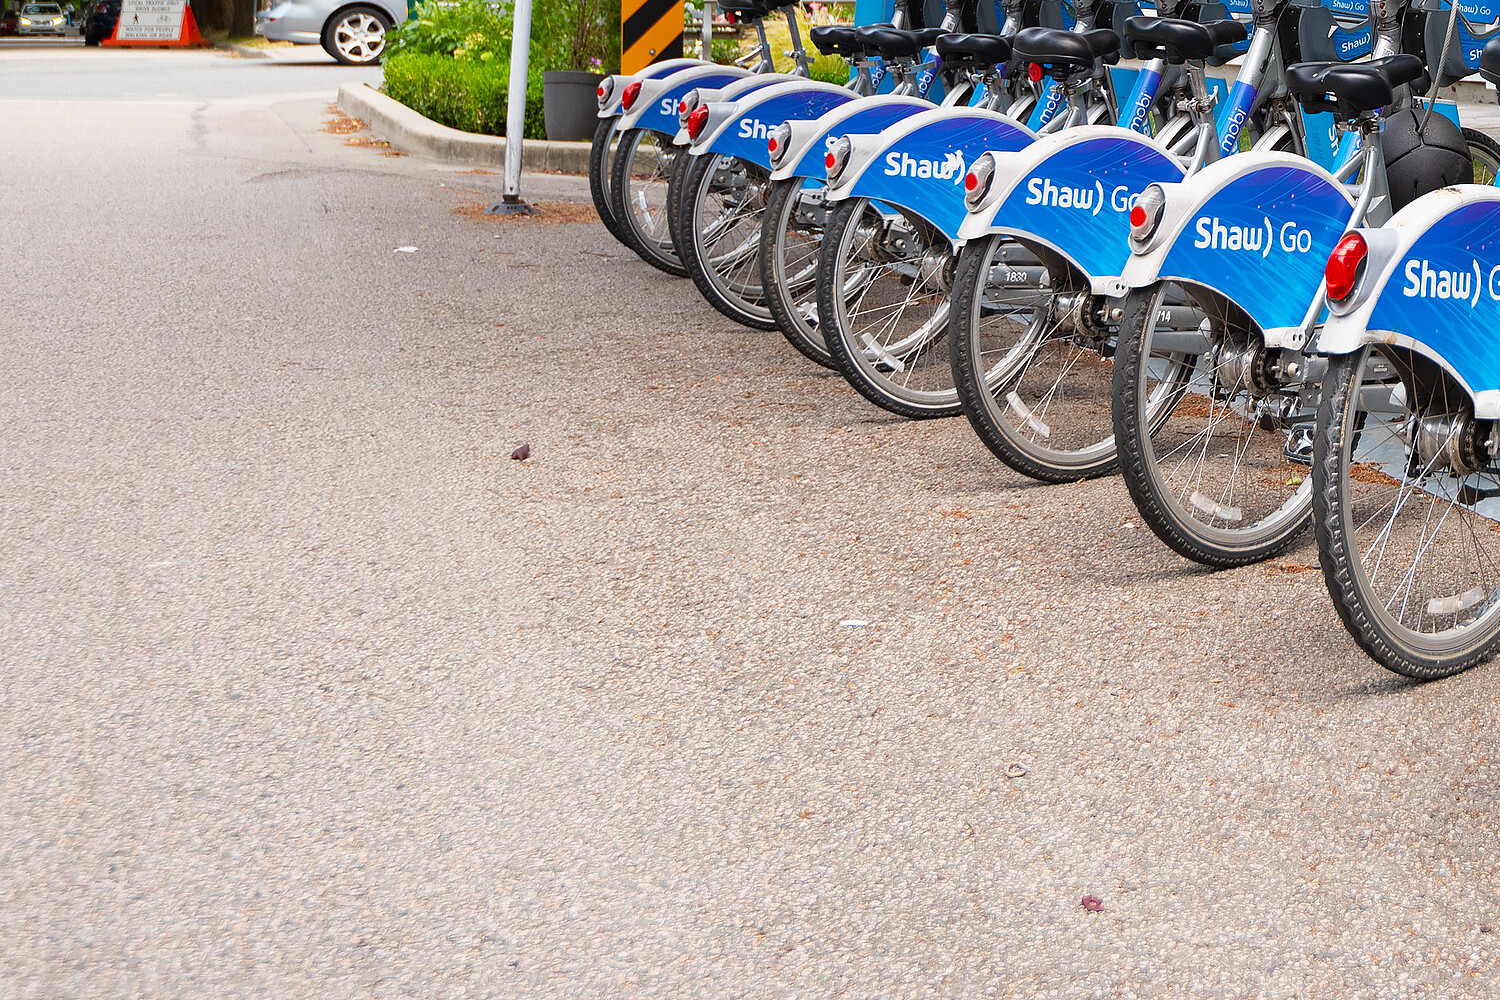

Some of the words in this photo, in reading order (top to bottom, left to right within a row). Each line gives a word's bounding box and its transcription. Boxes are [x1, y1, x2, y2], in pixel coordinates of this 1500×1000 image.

[1354, 2, 1365, 11] Go
[1480, 6, 1491, 16] Go
[1039, 92, 1062, 124] mob
[1130, 92, 1152, 131] mobi
[1221, 107, 1247, 152] mobi
[1280, 221, 1312, 253] Go
